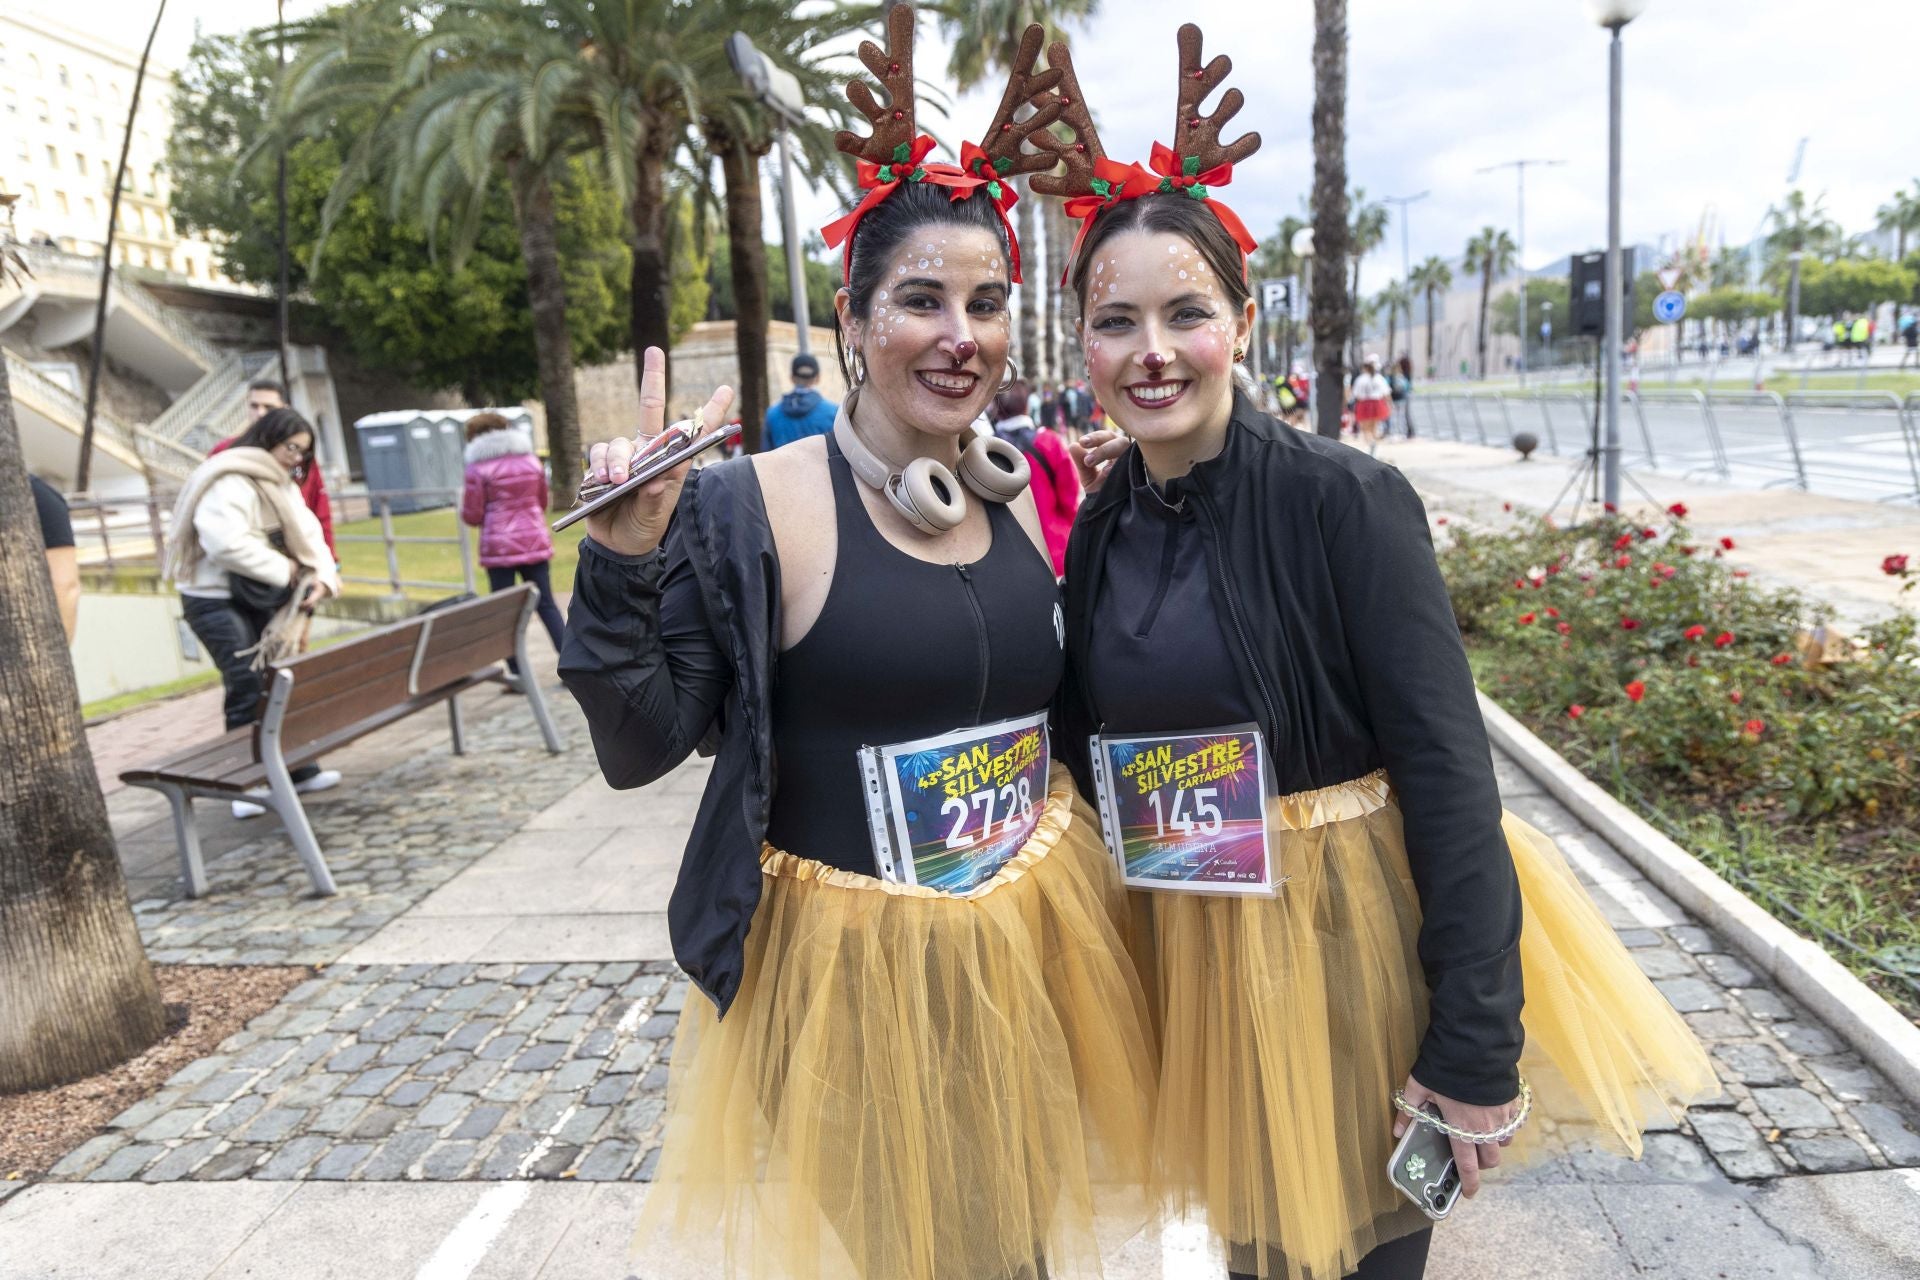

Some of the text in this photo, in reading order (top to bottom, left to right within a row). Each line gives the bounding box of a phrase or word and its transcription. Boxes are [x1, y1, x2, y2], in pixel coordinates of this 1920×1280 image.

[1264, 284, 1287, 308] P
[942, 742, 989, 781] SAN
[943, 730, 1040, 802] SILVESTRE
[996, 749, 1040, 788] CARTAGENA
[1135, 744, 1172, 774] SAN
[1136, 738, 1241, 795] SILVESTRE
[1178, 760, 1245, 791] CARTAGENA
[940, 776, 1033, 849] 2728
[1148, 787, 1223, 837] 145
